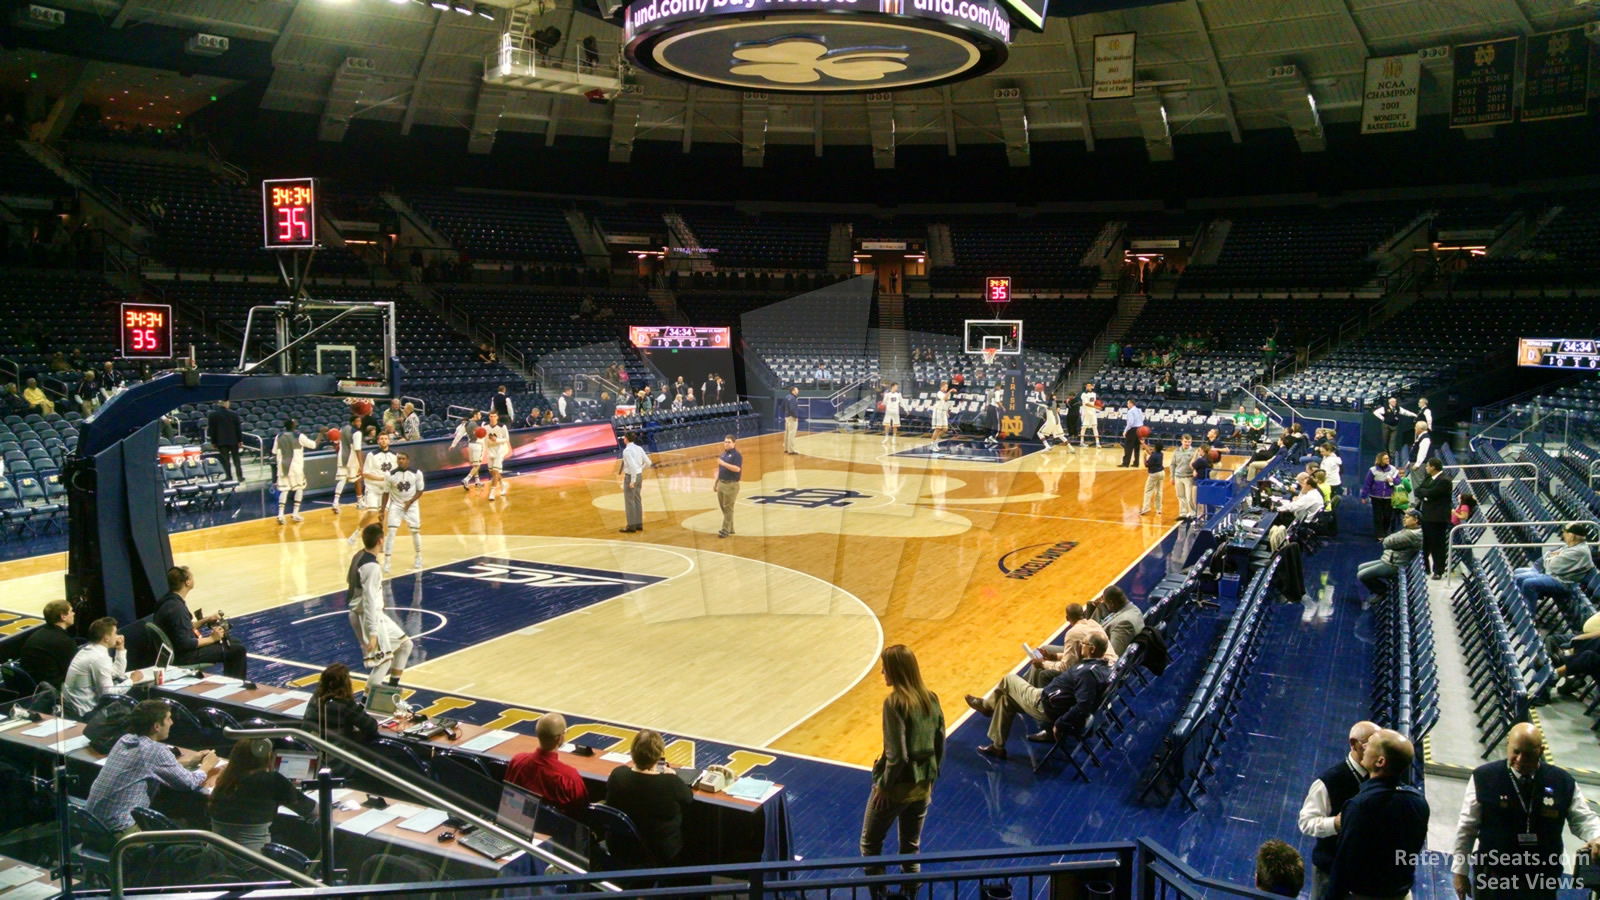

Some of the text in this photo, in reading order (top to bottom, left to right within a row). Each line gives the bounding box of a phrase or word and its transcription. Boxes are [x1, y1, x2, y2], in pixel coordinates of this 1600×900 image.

[1486, 73, 1510, 82] FOUR
[1378, 80, 1405, 89] NCAA
[1488, 84, 1507, 93] 2001
[1366, 88, 1416, 100] CHAMPION
[1488, 94, 1506, 102] 2012
[1381, 102, 1400, 110] 2001
[1374, 113, 1406, 122] WOMEN'S
[1367, 121, 1410, 130] BASKETBALL
[273, 187, 310, 206] 34:34
[992, 287, 1006, 299] 35
[126, 311, 162, 327] 34:34
[669, 328, 691, 336] 34:34
[132, 330, 156, 349] 35
[715, 335, 721, 343] 0
[1564, 342, 1592, 352] 34:34
[1528, 350, 1535, 360] 0
